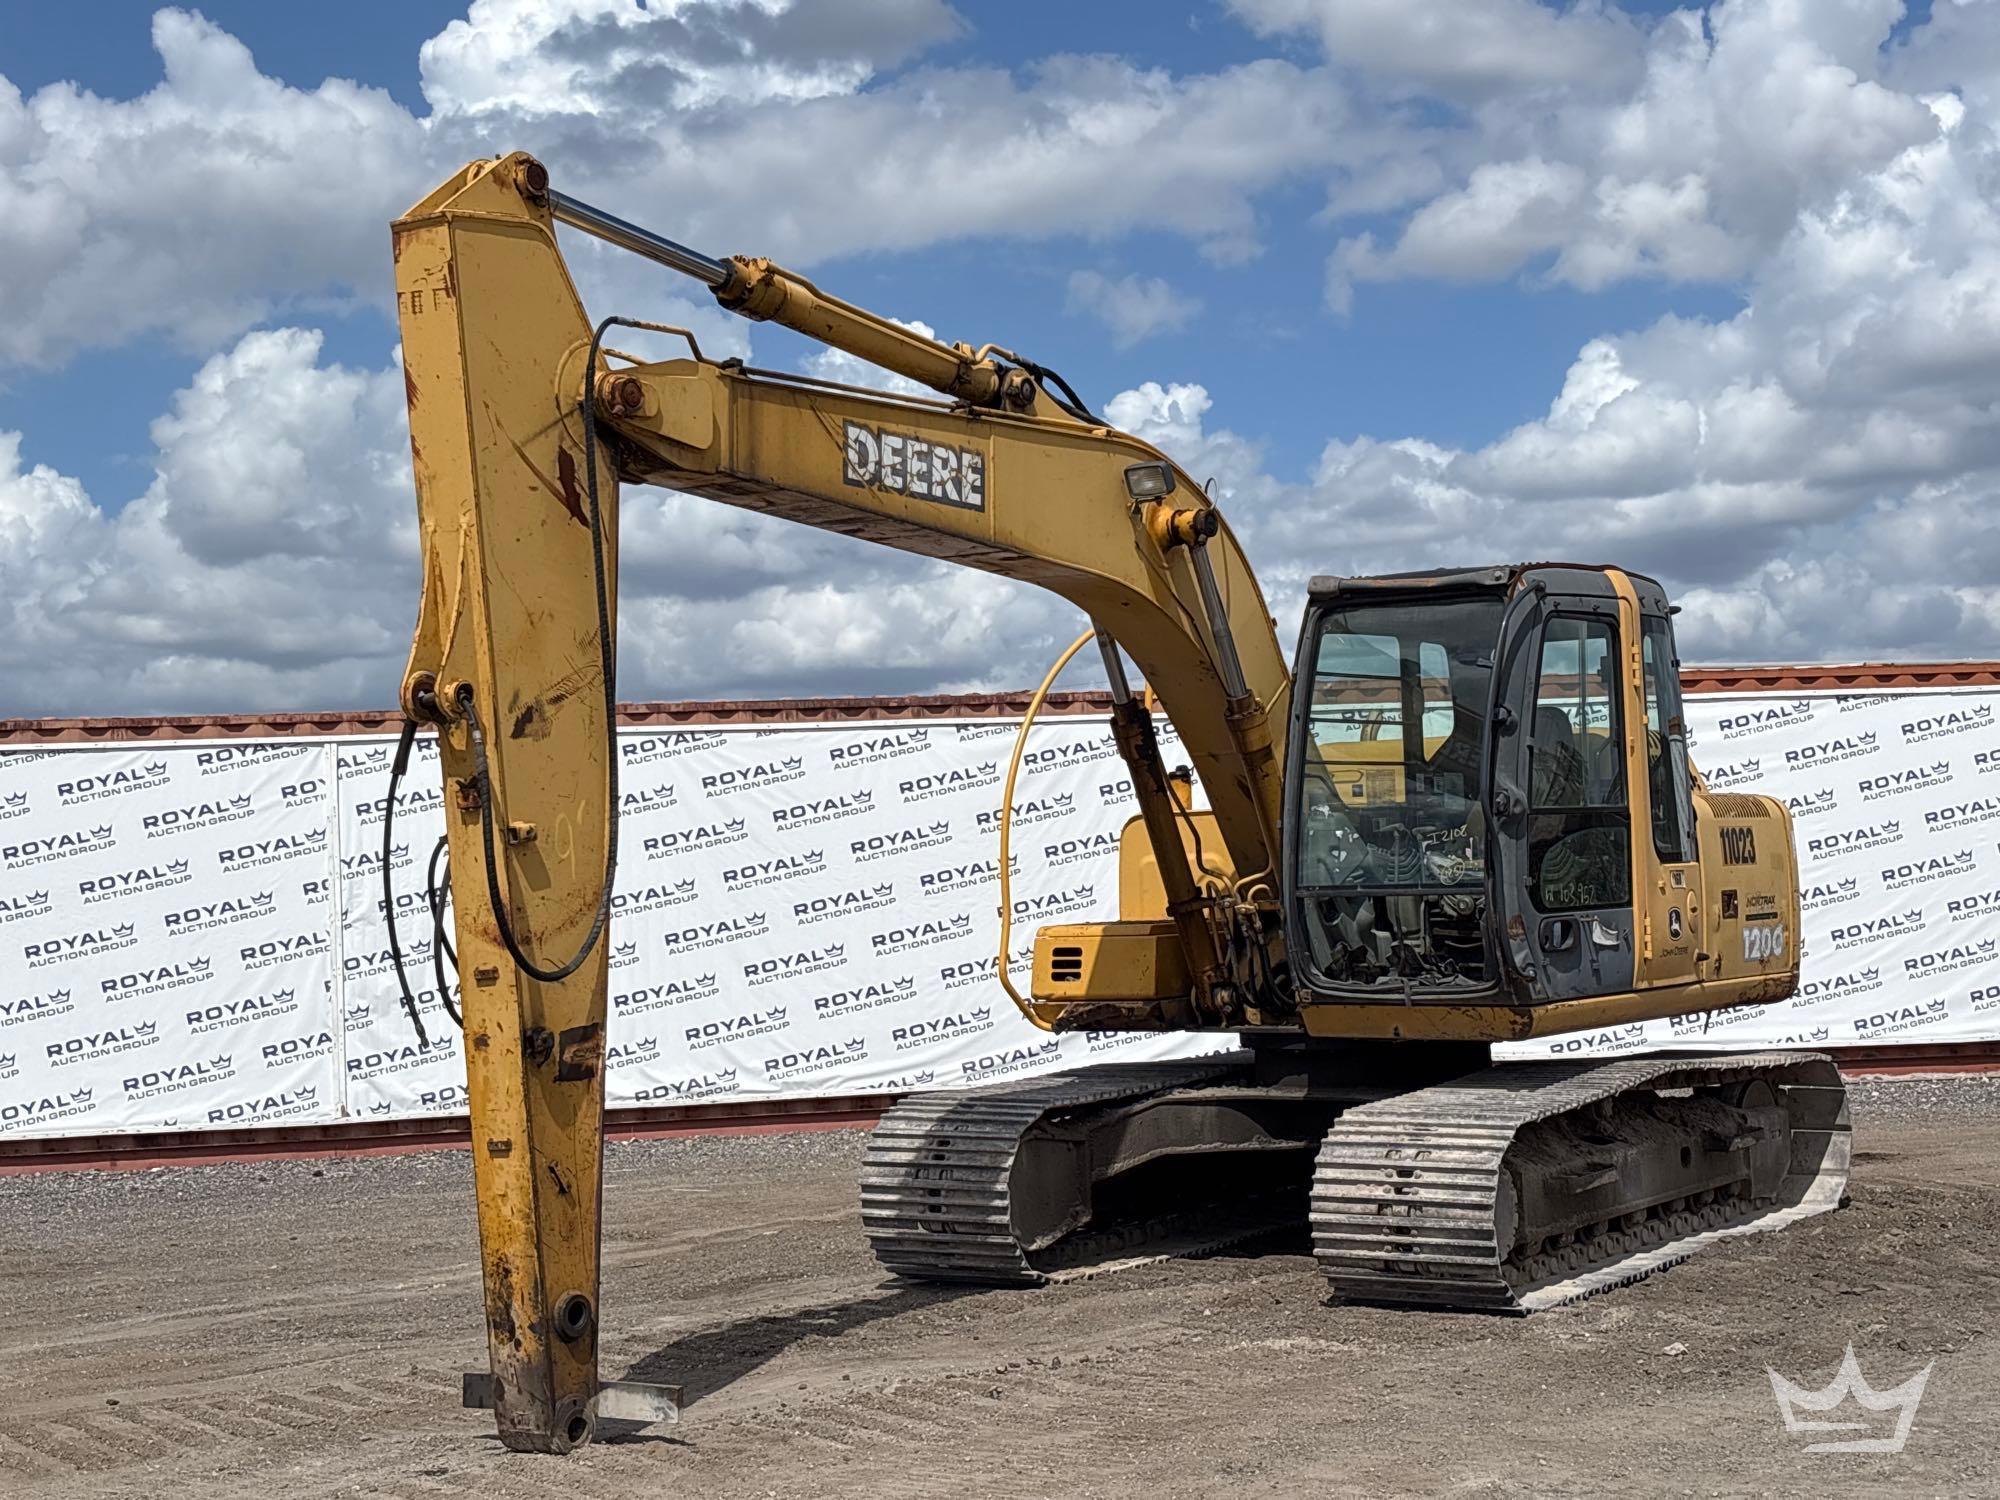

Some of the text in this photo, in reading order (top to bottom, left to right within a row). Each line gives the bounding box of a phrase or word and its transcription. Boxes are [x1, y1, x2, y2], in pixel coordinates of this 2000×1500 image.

[847, 425, 982, 506] DEERE
[1719, 706, 1793, 732] ROYAL
[1723, 714, 1814, 740] AUCTION GROUP
[1901, 711, 1974, 736] ROYAL
[1906, 718, 1995, 744] AUCTION GROUP
[622, 730, 704, 757] ROYAL
[627, 739, 727, 766] AUCTION GROUP
[829, 735, 909, 762] ROYAL
[834, 743, 931, 770] AUCTION GROUP
[1023, 740, 1102, 767] ROYAL
[1785, 738, 1859, 763] ROYAL
[201, 747, 308, 776] AUCTION GROUP
[1027, 758, 1080, 775] AUCTION
[1790, 745, 1880, 772] AUCTION GROUP
[57, 769, 145, 797] ROYAL
[701, 763, 783, 789] ROYAL
[706, 771, 806, 798] AUCTION GROUP
[899, 768, 978, 795] ROYAL
[903, 776, 1000, 803] AUCTION GROUP
[1724, 772, 1764, 787] GROUP
[1858, 767, 1932, 793] ROYAL
[1863, 775, 1953, 802] AUCTION GROUP
[62, 777, 170, 806] AUCTION GROUP
[142, 801, 230, 830] ROYAL
[634, 799, 677, 814] GROUP
[772, 796, 853, 823] ROYAL
[777, 804, 876, 832] AUCTION GROUP
[1034, 807, 1076, 822] GROUP
[1798, 802, 1838, 817] GROUP
[1924, 799, 1997, 825] ROYAL
[147, 809, 255, 839] AUCTION GROUP
[643, 824, 725, 852] ROYAL
[1929, 816, 1978, 833] AUCTION
[2, 832, 91, 860] ROYAL
[218, 835, 305, 864] ROYAL
[648, 832, 748, 860] AUCTION GROUP
[850, 827, 930, 854] ROYAL
[855, 835, 953, 863] AUCTION GROUP
[1043, 832, 1122, 859] ROYAL
[1720, 827, 1756, 865] 11023
[1808, 826, 1882, 852] ROYAL
[1813, 834, 1903, 861] AUCTION GROUP
[7, 840, 116, 870] AUCTION GROUP
[223, 854, 281, 873] AUCTION
[1048, 850, 1101, 867] AUCTION
[1881, 856, 1955, 882] ROYAL
[79, 866, 167, 895] ROYAL
[723, 856, 804, 883] ROYAL
[727, 864, 827, 892] AUCTION GROUP
[919, 860, 999, 888] ROYAL
[1886, 863, 1976, 891] AUCTION GROUP
[84, 874, 192, 904] AUCTION GROUP
[924, 878, 977, 896] AUCTION
[164, 898, 252, 927] ROYAL
[793, 889, 874, 917] ROYAL
[798, 897, 896, 926] AUCTION GROUP
[1055, 899, 1097, 915] GROUP
[169, 906, 277, 937] AUCTION GROUP
[664, 919, 746, 946] ROYAL
[871, 920, 951, 948] ROYAL
[1830, 916, 1905, 942] ROYAL
[24, 930, 113, 959] ROYAL
[240, 932, 327, 961] ROYAL
[669, 927, 769, 955] AUCTION GROUP
[876, 928, 973, 957] AUCTION GROUP
[1835, 923, 1926, 950] AUCTION GROUP
[29, 938, 138, 968] AUCTION GROUP
[245, 951, 304, 970] AUCTION
[743, 950, 825, 978] ROYAL
[1904, 945, 1978, 972] ROYAL
[1909, 953, 1999, 980] AUCTION GROUP
[101, 964, 189, 993] ROYAL
[748, 958, 848, 987] AUCTION GROUP
[945, 971, 999, 989] AUCTION
[106, 972, 214, 1003] AUCTION GROUP
[613, 980, 696, 1008] ROYAL
[814, 983, 894, 1011] ROYAL
[1792, 981, 1883, 1008] AUCTION GROUP
[27, 1004, 74, 1021] GROUP
[186, 996, 273, 1025] ROYAL
[618, 988, 719, 1017] AUCTION GROUP
[819, 991, 917, 1020] AUCTION GROUP
[191, 1004, 298, 1035] AUCTION GROUP
[685, 1013, 767, 1042] ROYAL
[892, 1014, 971, 1042] ROYAL
[1853, 1005, 1928, 1032] ROYAL
[1859, 1012, 1949, 1040] AUCTION GROUP
[46, 1028, 135, 1058] ROYAL
[689, 1021, 790, 1050] AUCTION GROUP
[896, 1021, 994, 1051] AUCTION GROUP
[51, 1036, 160, 1067] AUCTION GROUP
[266, 1049, 325, 1068] AUCTION
[764, 1045, 845, 1072] ROYAL
[961, 1047, 1041, 1075] ROYAL
[123, 1062, 211, 1092] ROYAL
[350, 1051, 457, 1081] AUCTION GROUP
[769, 1052, 868, 1081] AUCTION GROUP
[965, 1054, 1062, 1082] AUCTION GROUP
[127, 1070, 236, 1101] AUCTION GROUP
[634, 1075, 717, 1103] ROYAL
[49, 1103, 96, 1120] GROUP
[207, 1094, 295, 1123] ROYAL
[273, 1101, 320, 1118] GROUP
